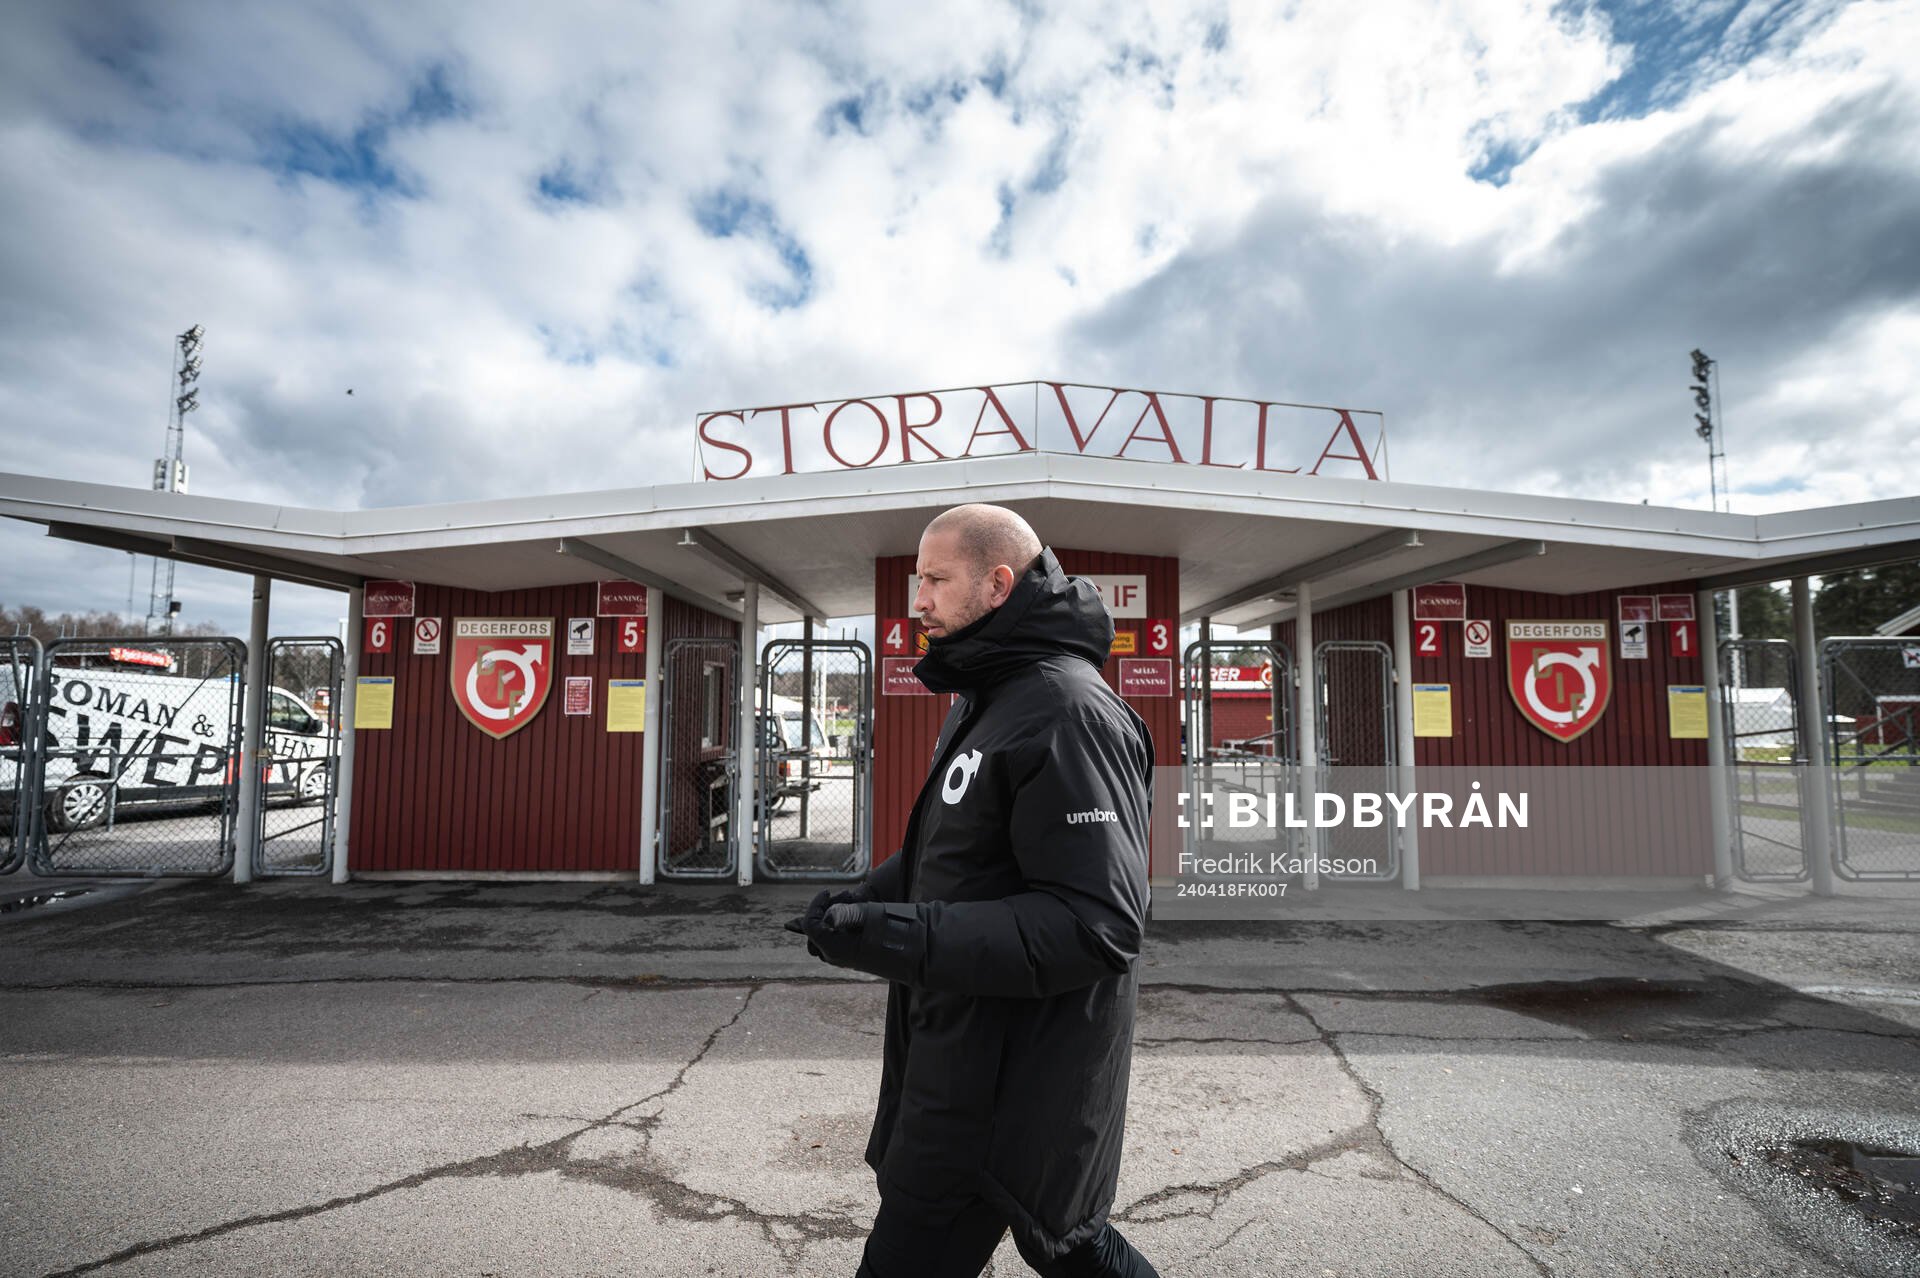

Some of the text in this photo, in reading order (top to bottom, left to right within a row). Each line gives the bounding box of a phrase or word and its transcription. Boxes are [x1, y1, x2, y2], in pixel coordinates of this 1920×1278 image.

[699, 381, 1381, 482] STORA VALLA
[367, 594, 409, 603] SCANNING
[602, 594, 643, 603] SCANNING
[1114, 585, 1138, 608] IF
[1419, 598, 1462, 606] SCANNING
[371, 621, 387, 649] 6
[460, 623, 548, 635] DEGERFORS
[623, 621, 639, 649] 5
[886, 623, 903, 649] 4
[1151, 623, 1169, 651] 3
[1419, 625, 1437, 652] 2
[1512, 625, 1602, 637] DEGERFORS
[1675, 625, 1689, 652] 1
[191, 713, 215, 738] &
[1066, 808, 1118, 825] umbro
